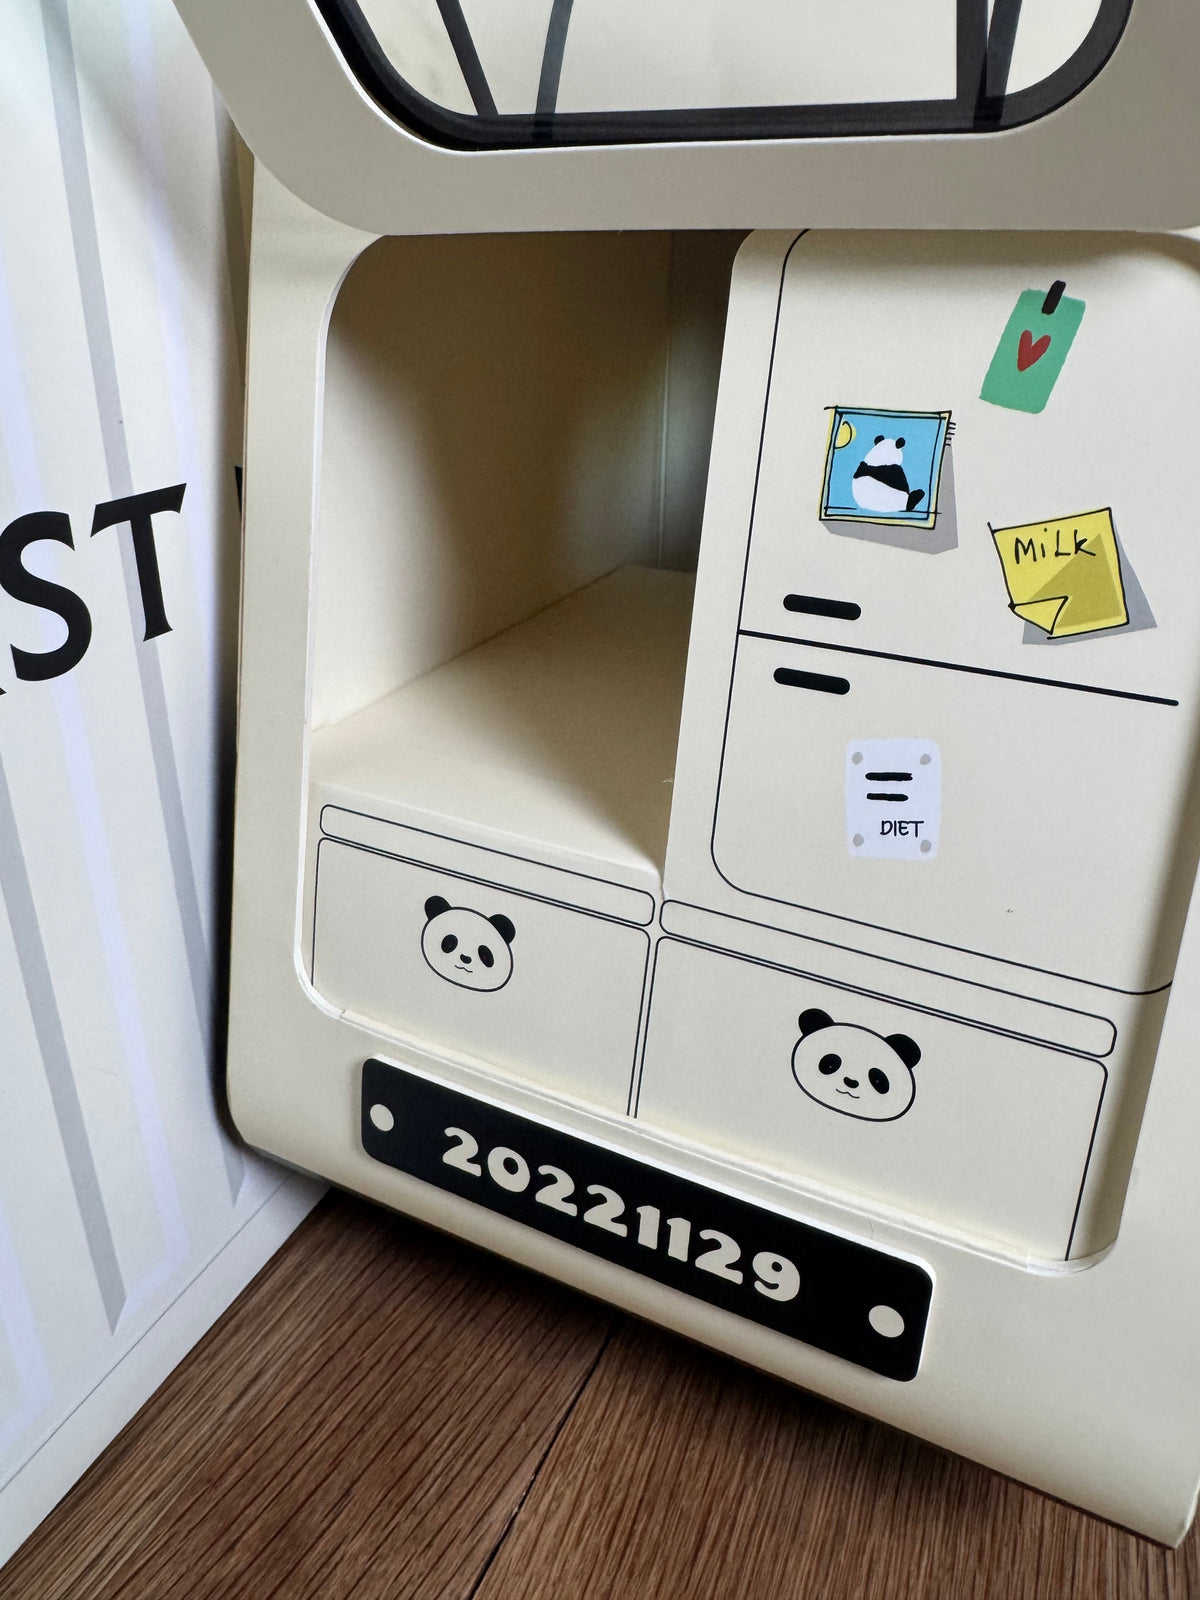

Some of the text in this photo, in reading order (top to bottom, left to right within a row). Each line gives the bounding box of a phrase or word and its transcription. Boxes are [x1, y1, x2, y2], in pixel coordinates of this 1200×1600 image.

[0, 482, 187, 695] ST
[880, 820, 925, 838] DIET
[442, 1126, 801, 1302] 20221129
